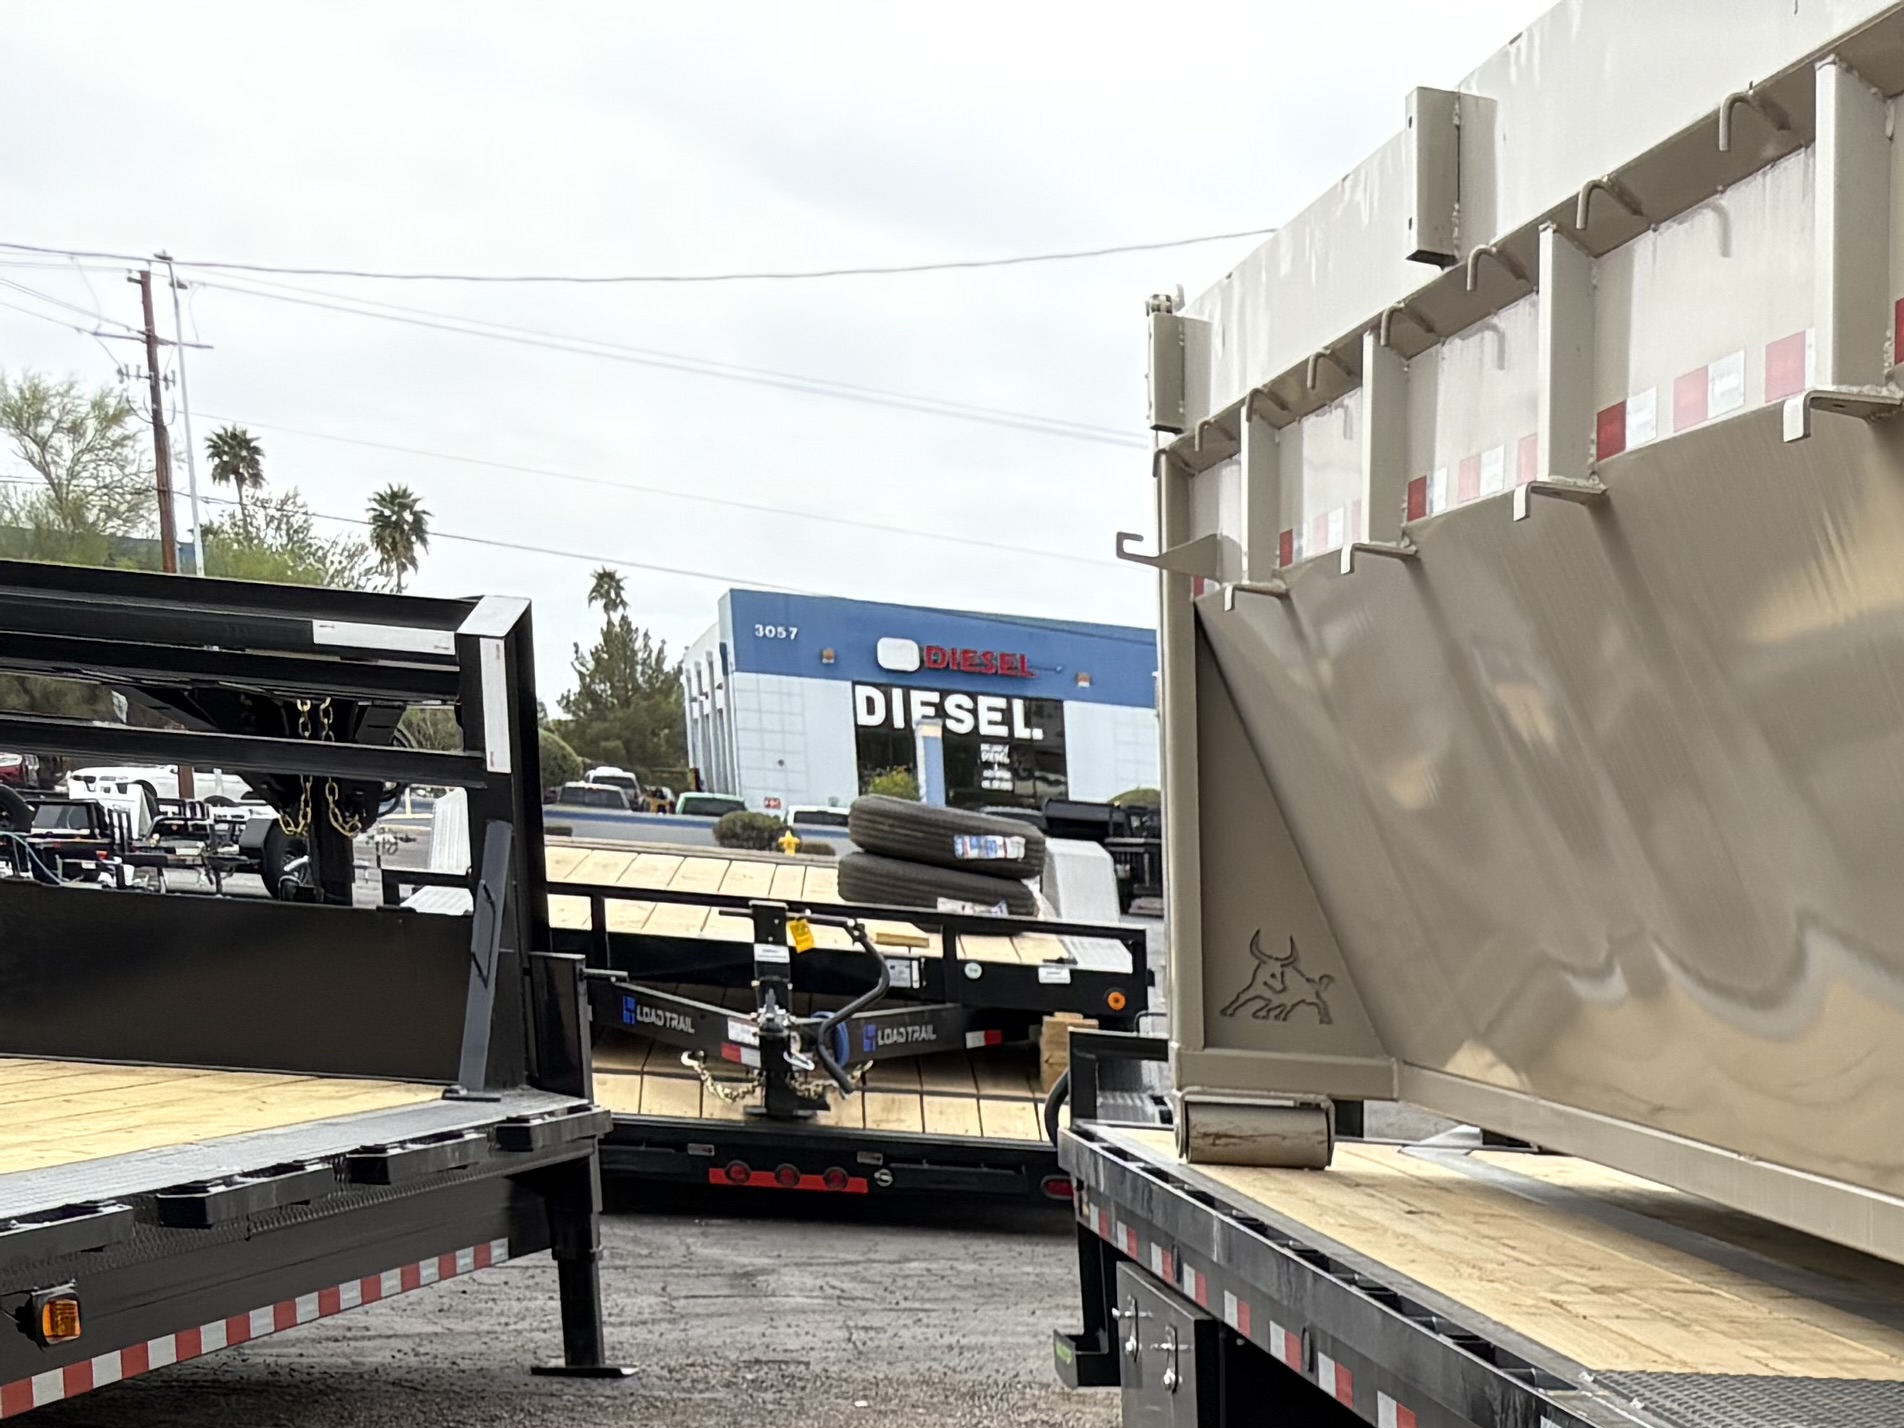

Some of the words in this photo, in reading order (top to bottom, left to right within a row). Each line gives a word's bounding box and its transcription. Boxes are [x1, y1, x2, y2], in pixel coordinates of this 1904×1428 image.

[754, 623, 799, 640] 3057
[924, 645, 1038, 678] DIESEL
[637, 1005, 664, 1026] LOAD
[878, 1027, 906, 1046] LOAD
